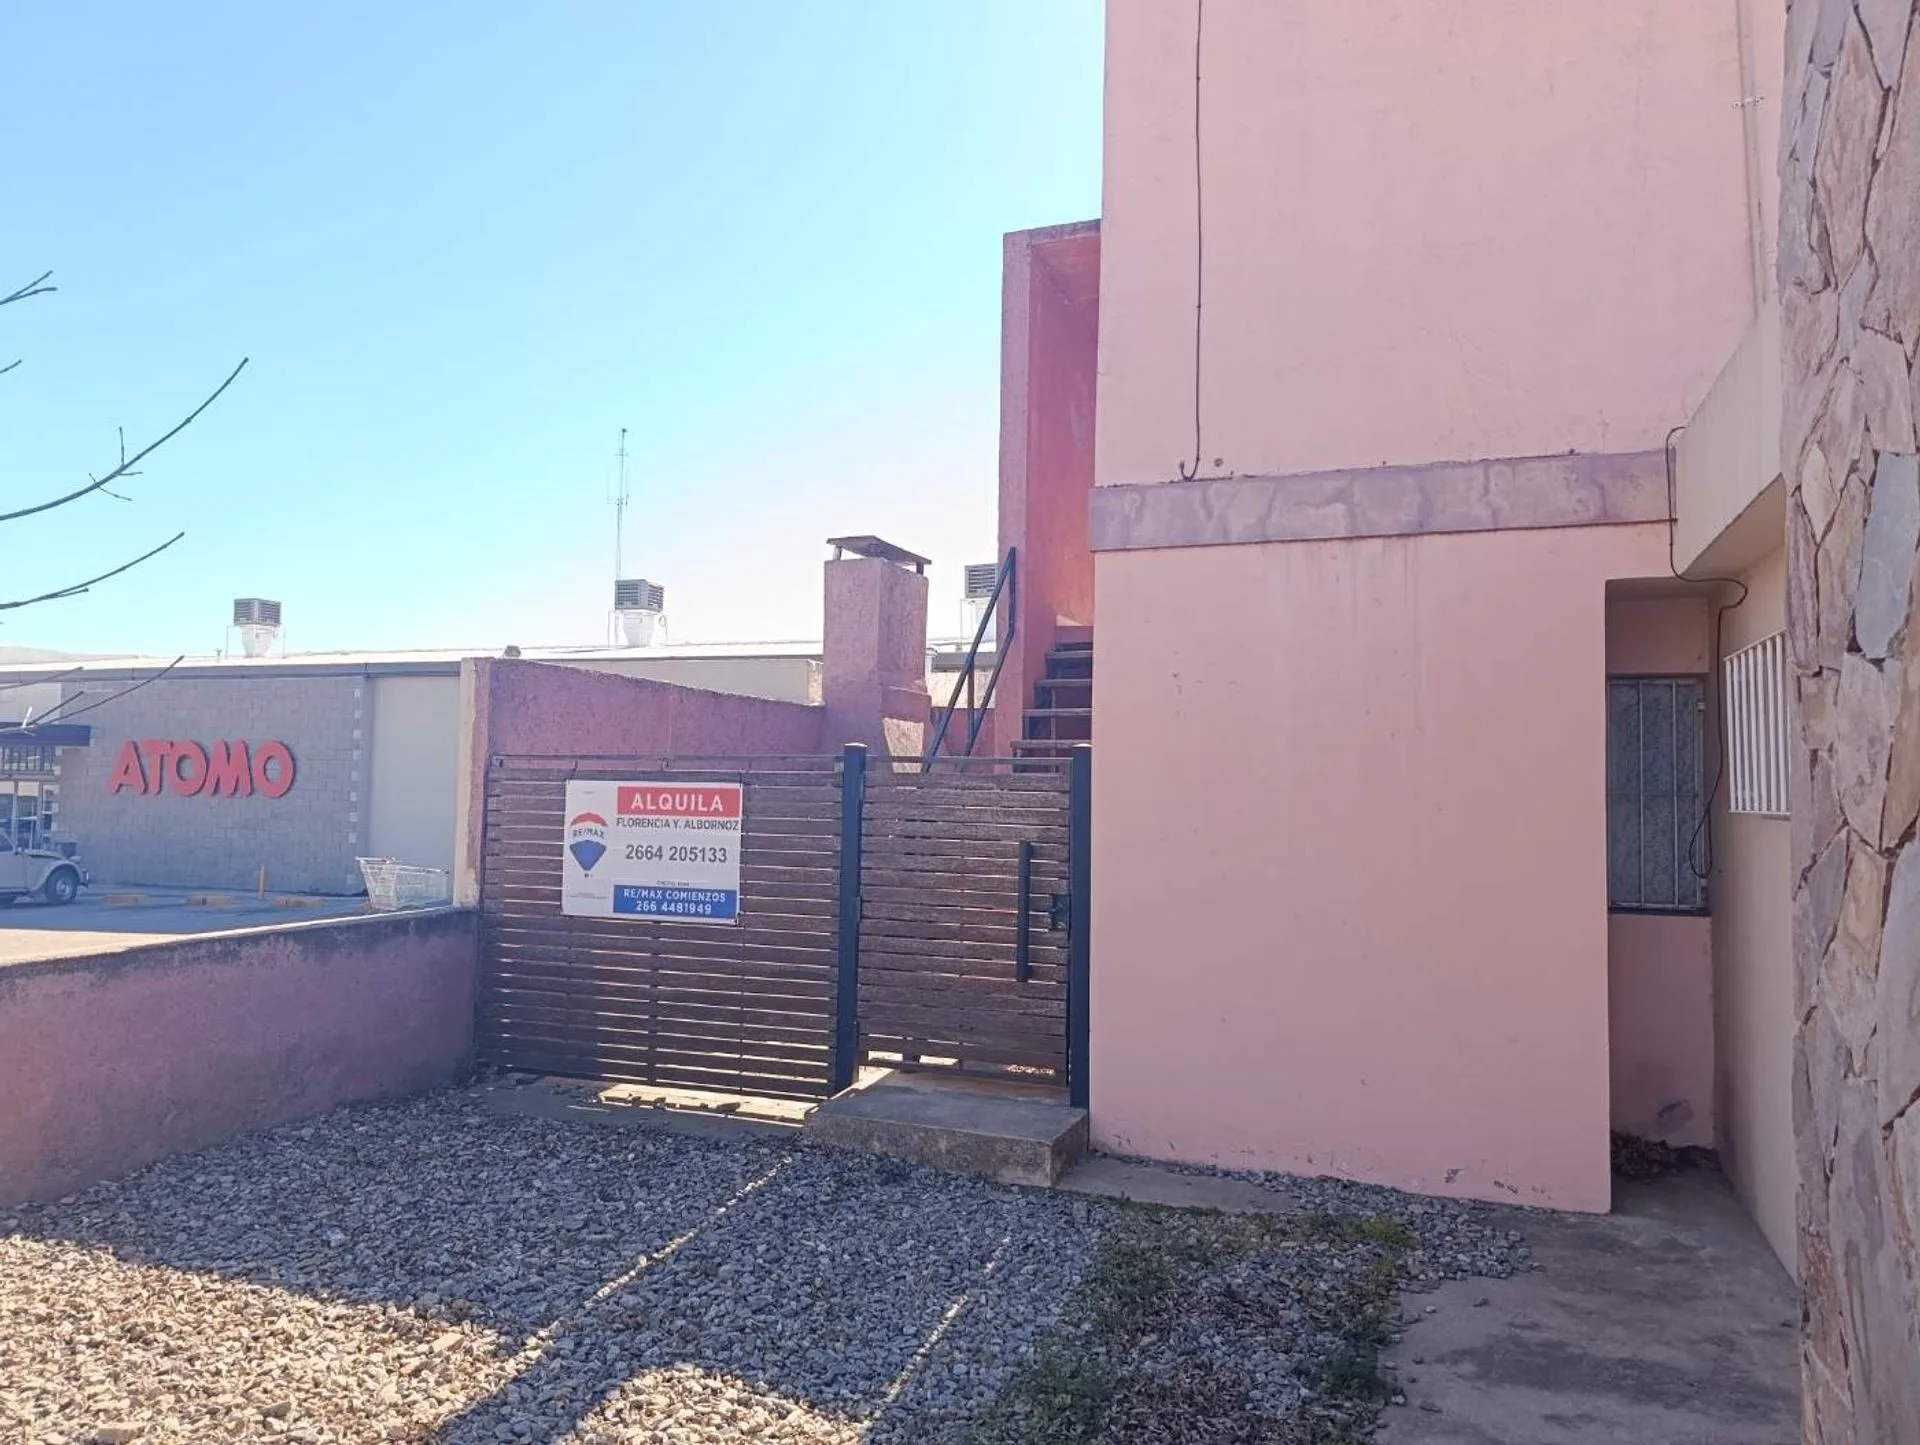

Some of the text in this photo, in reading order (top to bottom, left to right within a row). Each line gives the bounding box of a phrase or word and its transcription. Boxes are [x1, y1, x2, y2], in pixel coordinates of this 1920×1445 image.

[108, 737, 296, 799] ATOMO
[631, 793, 724, 812] ALQUILA
[616, 818, 671, 829] FLORENCIA
[684, 819, 740, 831] ALBORNOZ
[572, 827, 605, 839] RE/MAX
[625, 844, 727, 863] 2664 205133
[623, 888, 726, 903] RE/MAX COMIENZOS
[636, 901, 712, 914] 266 4481949
